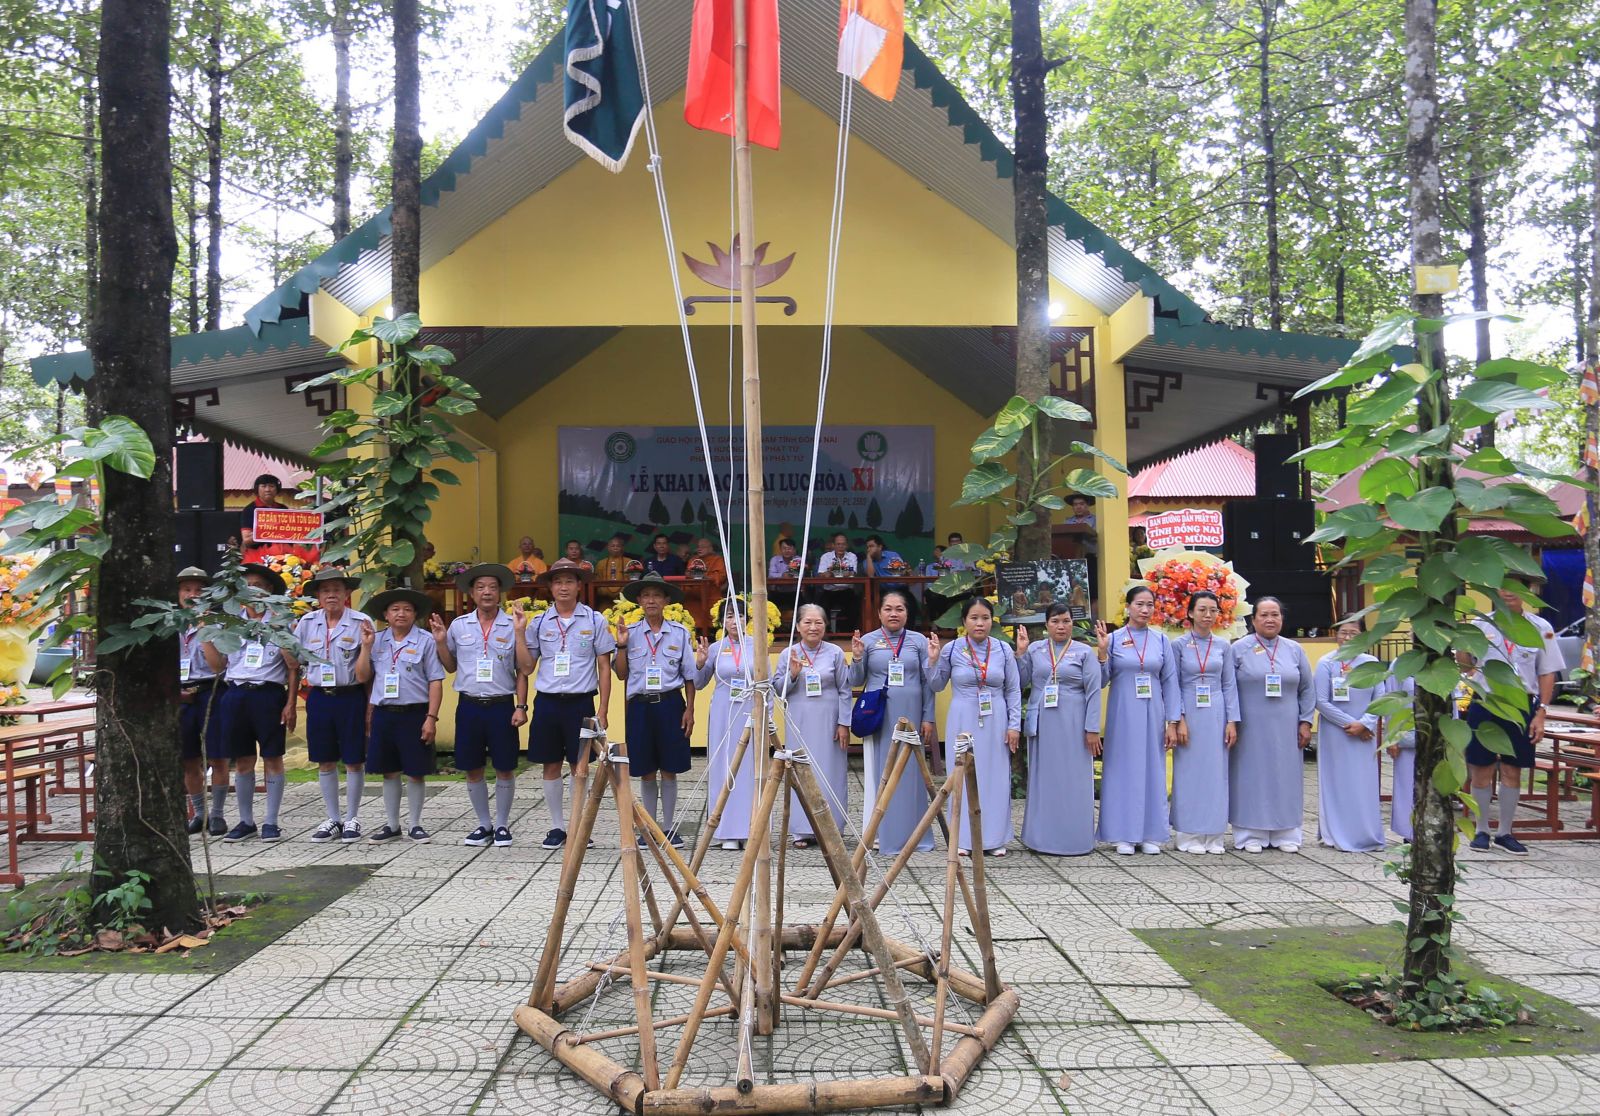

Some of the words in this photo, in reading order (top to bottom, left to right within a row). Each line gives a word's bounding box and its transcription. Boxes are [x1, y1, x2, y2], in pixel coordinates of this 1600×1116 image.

[654, 474, 694, 492] KHAI
[815, 469, 848, 491] HÒA
[851, 467, 874, 491] XI
[1149, 517, 1161, 527] BAN
[1149, 527, 1172, 537] TỈNH
[1174, 523, 1200, 534] ĐỒNG
[1203, 526, 1220, 534] NAI
[1150, 535, 1182, 547] CHÚC
[1185, 534, 1220, 544] MỪNG
